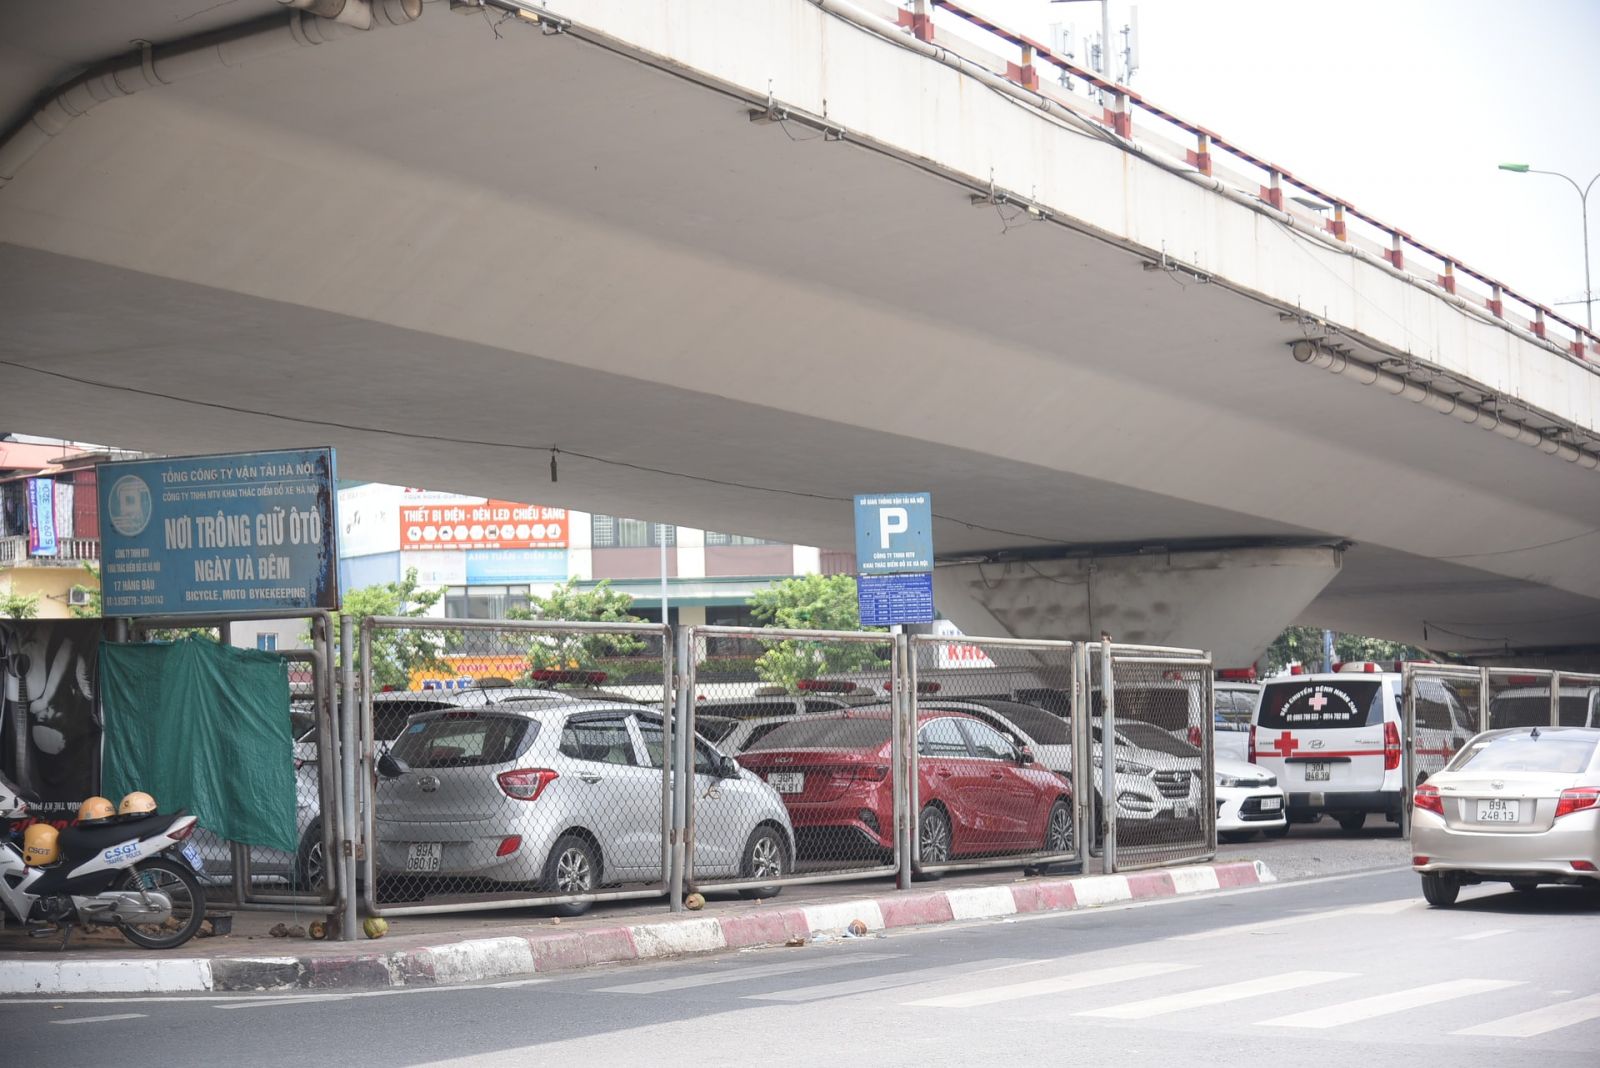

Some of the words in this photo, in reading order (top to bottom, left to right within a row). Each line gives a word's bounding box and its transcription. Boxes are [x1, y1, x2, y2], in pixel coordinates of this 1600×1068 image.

[161, 467, 188, 483] TỔNG
[190, 468, 218, 482] CÔNG
[220, 468, 234, 480] TY
[236, 465, 257, 480] VẬN
[260, 464, 276, 476] TẢI
[278, 462, 294, 476] HÀ
[296, 462, 314, 476] NỘI
[162, 490, 180, 502] CÔNG
[181, 491, 188, 501] TY
[286, 486, 294, 495] XE
[404, 507, 430, 522] THIẾT
[432, 509, 442, 524] BỊ
[444, 508, 465, 524] ĐIỆN
[493, 509, 510, 520] LED
[164, 514, 192, 550] NƠI
[196, 510, 251, 548] TRÔNG
[256, 506, 285, 547] GIỮ
[290, 506, 321, 545] ÔTÔ
[880, 508, 908, 549] P
[194, 555, 232, 582] NGÀY
[236, 554, 254, 581] VÀ
[258, 553, 290, 580] ĐÊM
[114, 581, 120, 591] 17
[223, 589, 246, 600] MOTO
[249, 588, 306, 600] BYKEKEEPING
[1489, 802, 1507, 810] 89A
[1481, 811, 1514, 820] 248.13
[416, 844, 433, 856] 89A
[407, 856, 438, 869] 080.18
